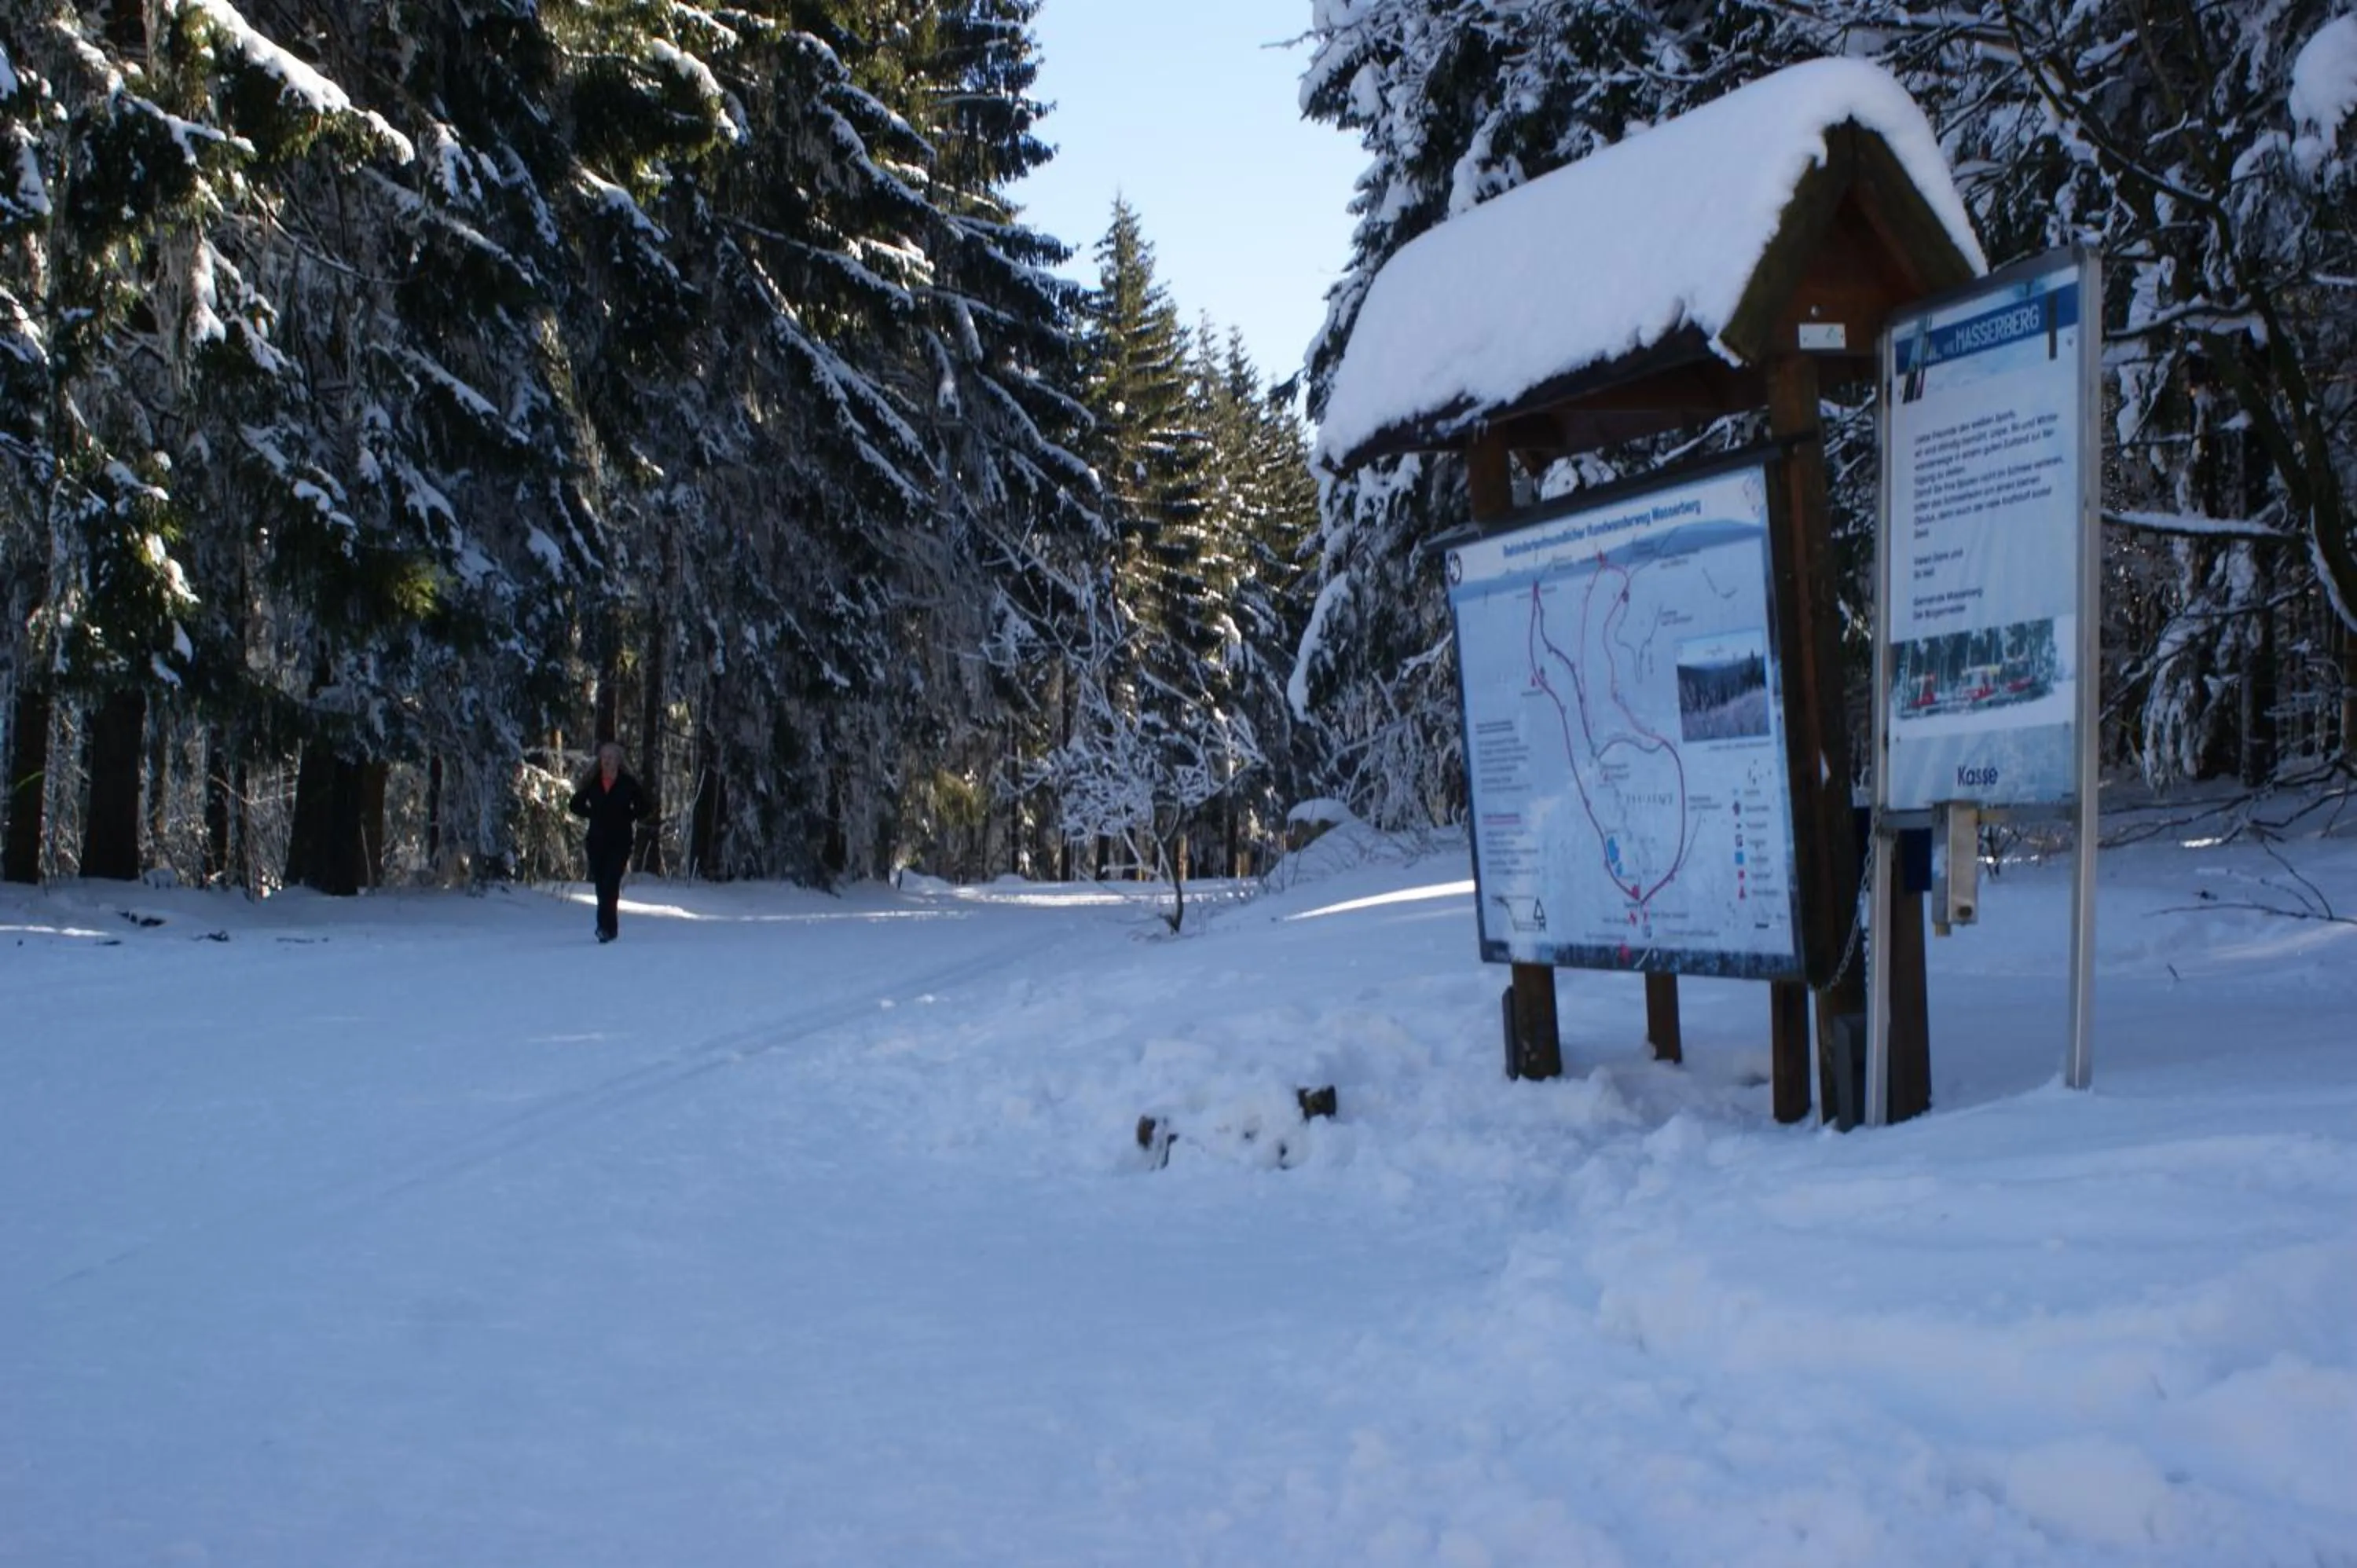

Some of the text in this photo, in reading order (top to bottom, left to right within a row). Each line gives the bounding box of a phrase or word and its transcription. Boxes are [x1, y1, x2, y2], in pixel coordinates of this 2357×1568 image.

[1956, 304, 2040, 353] MASSERBERG
[1652, 500, 1701, 520] Masserberg
[1957, 766, 1998, 786] Kasse
